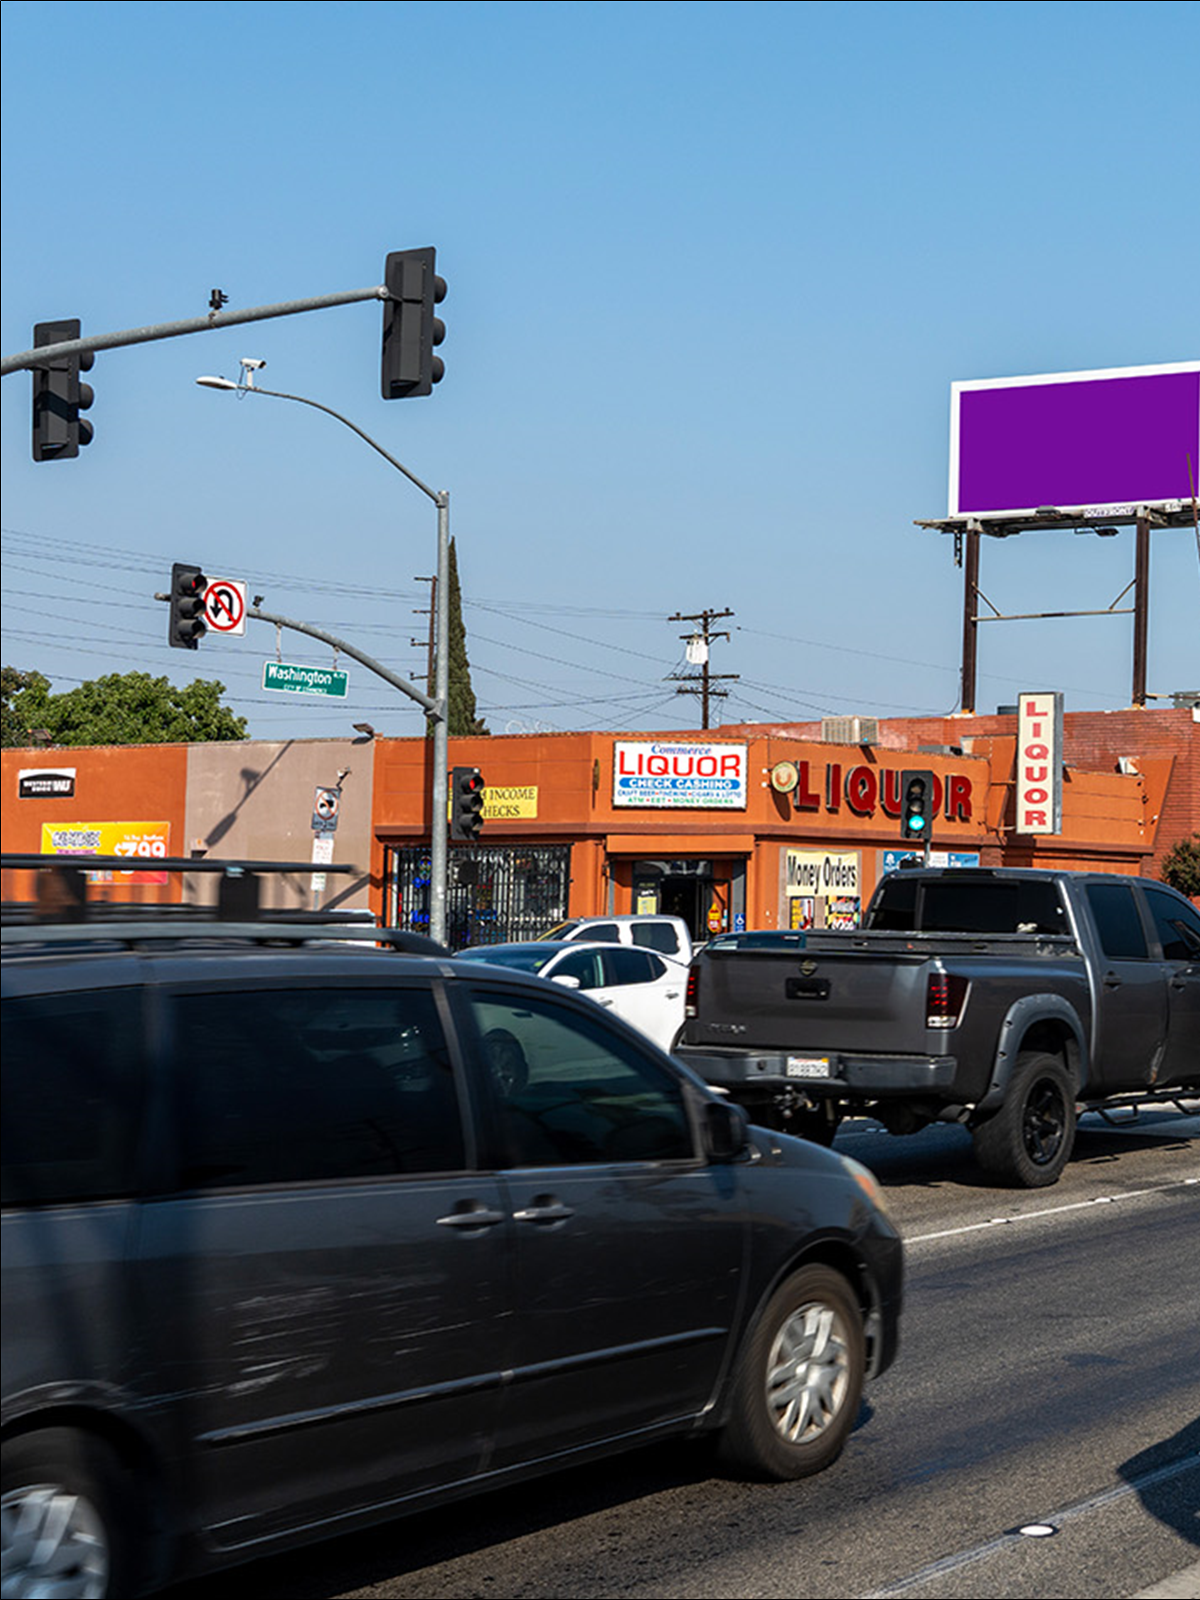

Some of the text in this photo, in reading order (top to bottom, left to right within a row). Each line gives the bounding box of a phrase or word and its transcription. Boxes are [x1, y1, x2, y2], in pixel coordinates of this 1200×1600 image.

[268, 664, 332, 687] Washington
[651, 743, 712, 755] Commerce
[619, 750, 740, 777] LIQUOR
[1023, 701, 1049, 826] LIQUOR
[490, 787, 536, 800] INCOME
[629, 779, 733, 790] CHECK CASHING
[483, 805, 521, 817] HECKS
[787, 855, 856, 894] Money Orders
